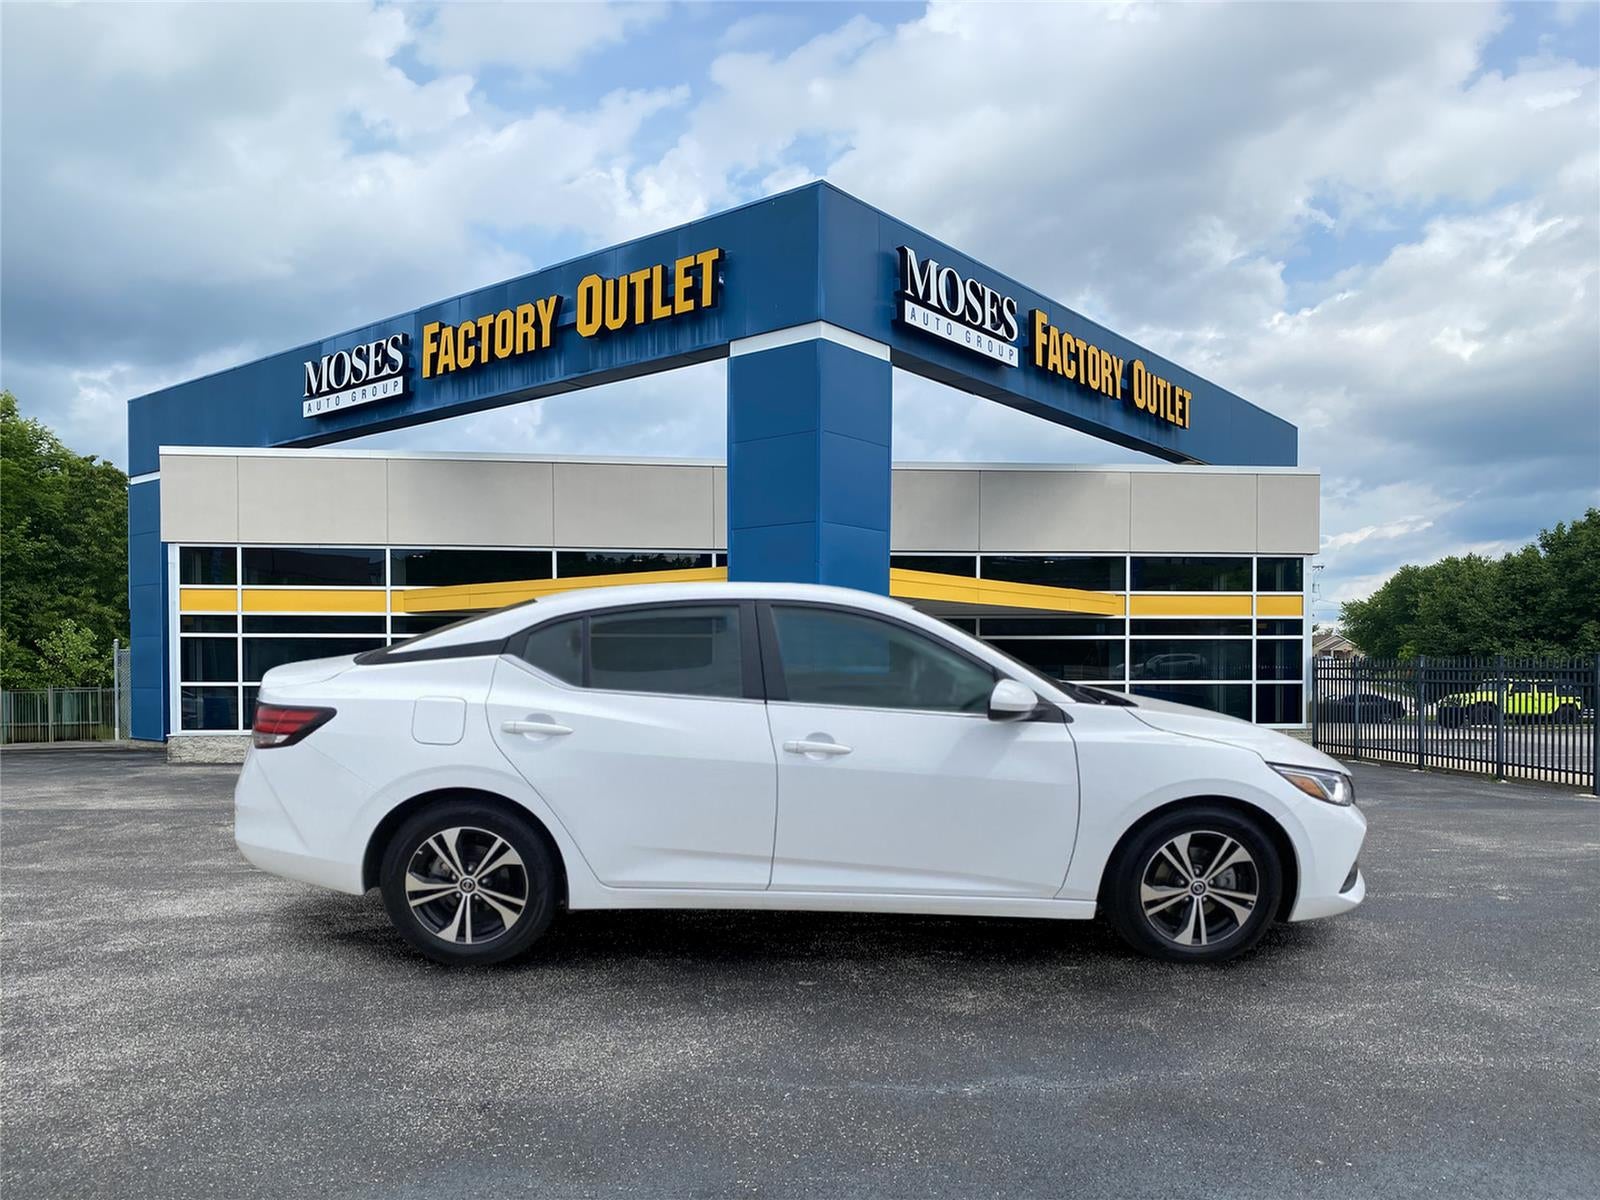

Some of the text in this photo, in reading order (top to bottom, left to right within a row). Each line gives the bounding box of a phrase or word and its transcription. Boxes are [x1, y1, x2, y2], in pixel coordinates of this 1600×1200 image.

[422, 247, 720, 379] FACTORY OUTLET
[904, 246, 1018, 342] MOSES
[910, 307, 1014, 360] AUTO GROUP
[303, 333, 404, 397] MOSES
[307, 380, 399, 413] AUTO GROUP
[1034, 309, 1192, 429] FACTORY OUTLET
